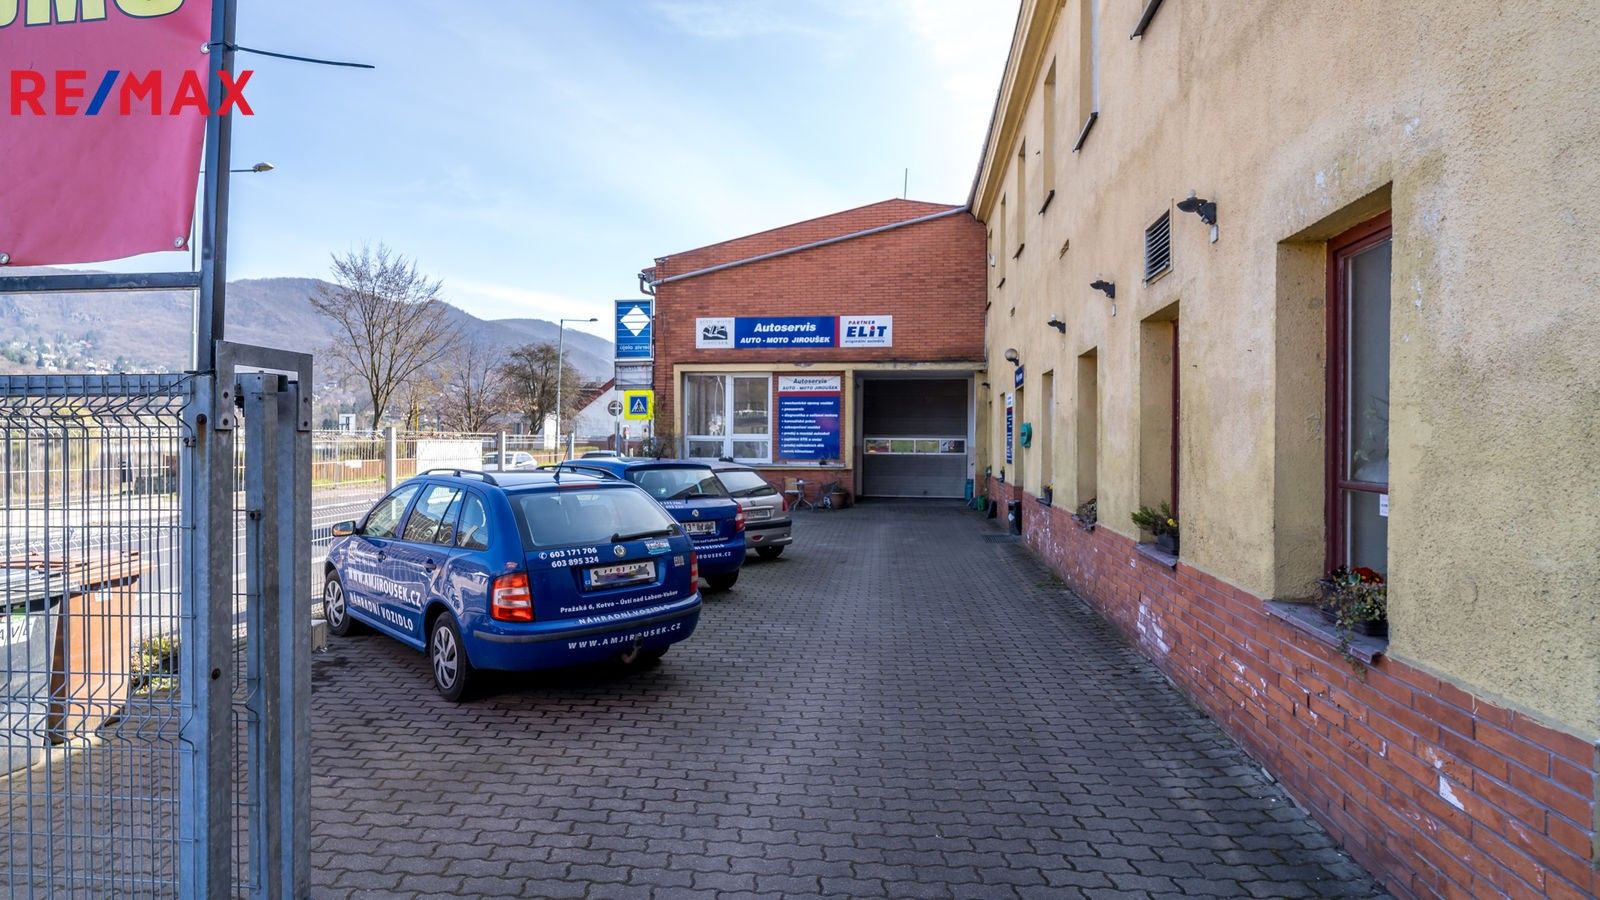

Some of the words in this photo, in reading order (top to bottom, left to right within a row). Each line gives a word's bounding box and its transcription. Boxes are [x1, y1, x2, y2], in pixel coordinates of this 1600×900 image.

[753, 322, 817, 333] Autoservis
[791, 335, 831, 344] JIROUŠEK
[549, 551, 565, 559] 603
[582, 547, 597, 555] 706
[551, 560, 567, 568] 603
[568, 558, 583, 566] 895
[584, 556, 599, 564] 324
[347, 567, 421, 607] WWW.AMJIROUSEK.CZ
[349, 591, 380, 616] NÁHRADNÍ
[380, 606, 414, 631] VOZIDLO
[560, 604, 587, 613] Pražská
[578, 610, 631, 625] NÁHRADNÍ
[632, 604, 671, 617] VOZIDLO
